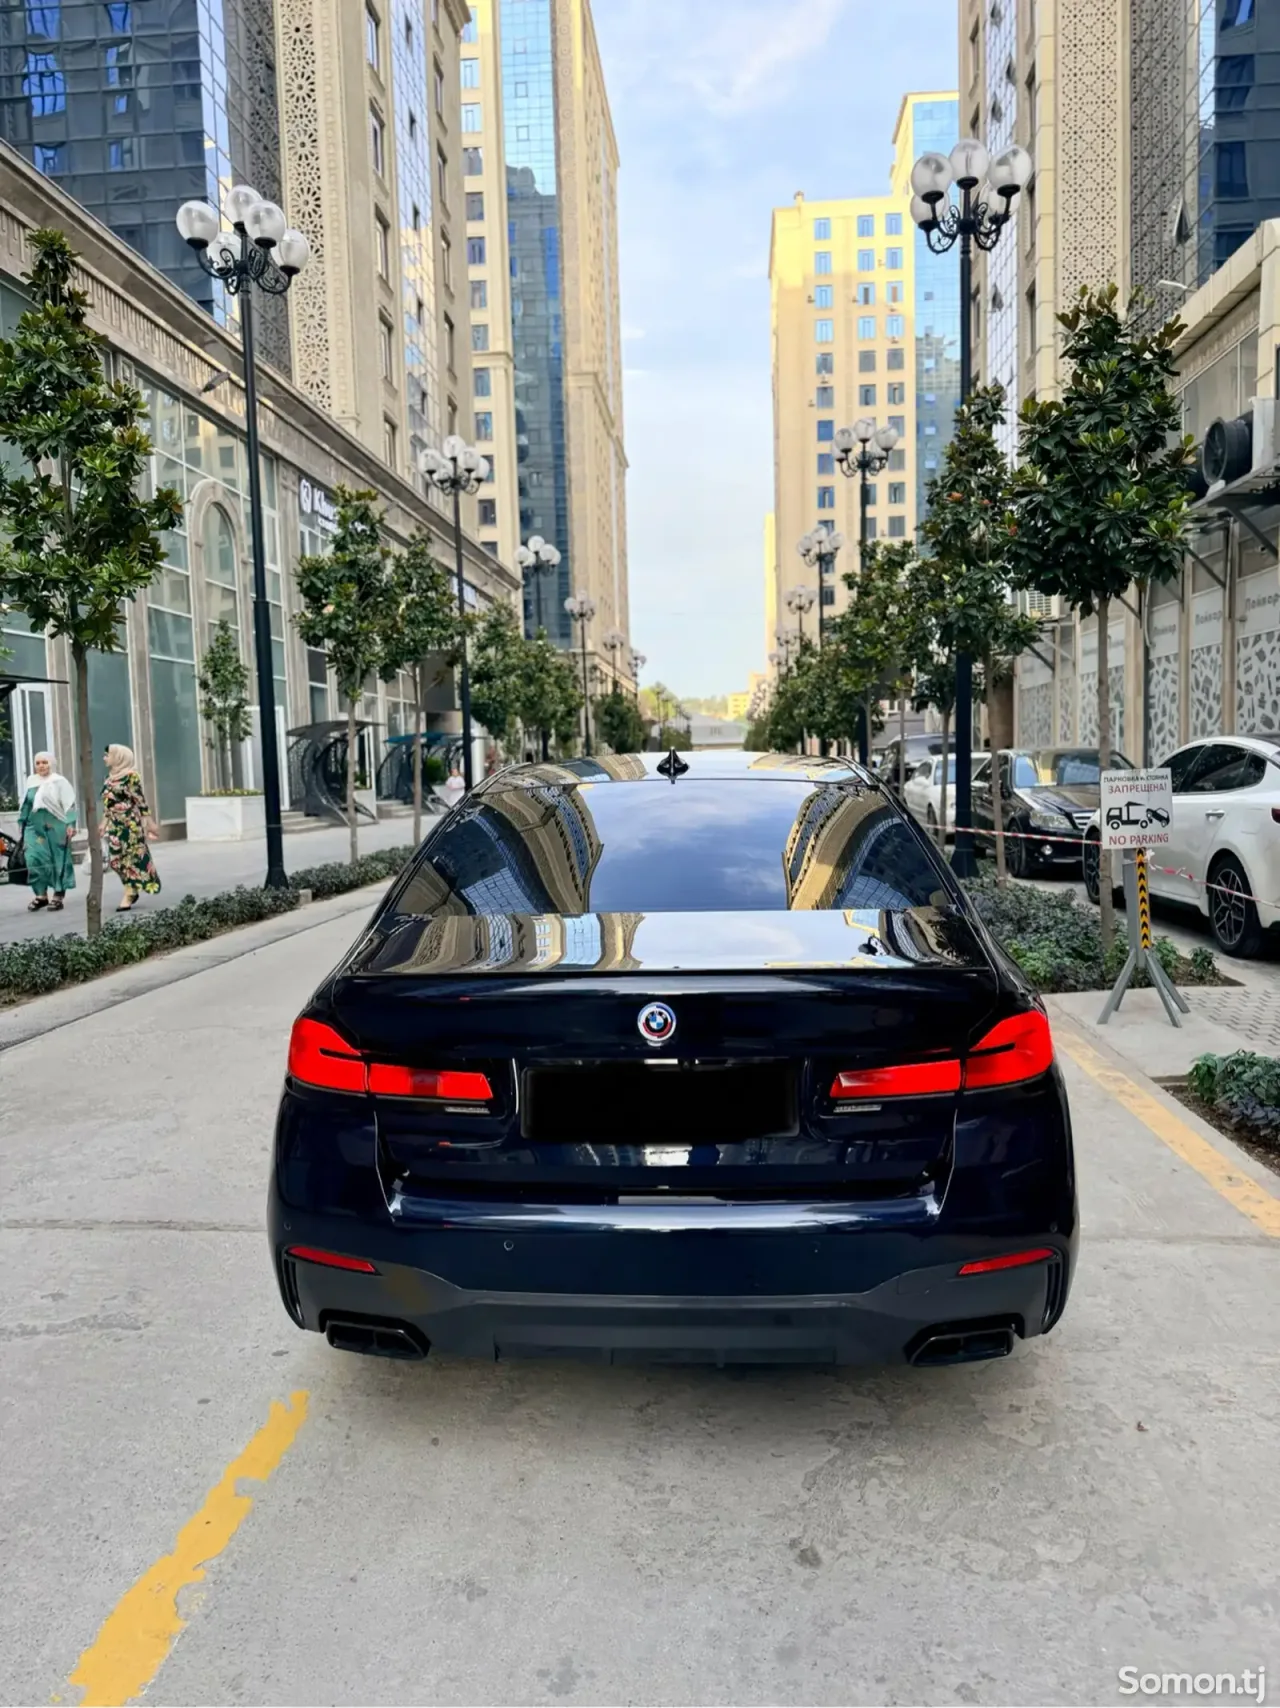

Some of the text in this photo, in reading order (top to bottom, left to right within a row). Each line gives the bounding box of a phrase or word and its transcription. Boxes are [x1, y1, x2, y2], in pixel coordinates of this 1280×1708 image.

[1103, 775, 1139, 783] ПАРКОВКА
[1108, 783, 1167, 794] ЗАПРЕЩЕНА!
[1108, 833, 1169, 846] NO PARKING
